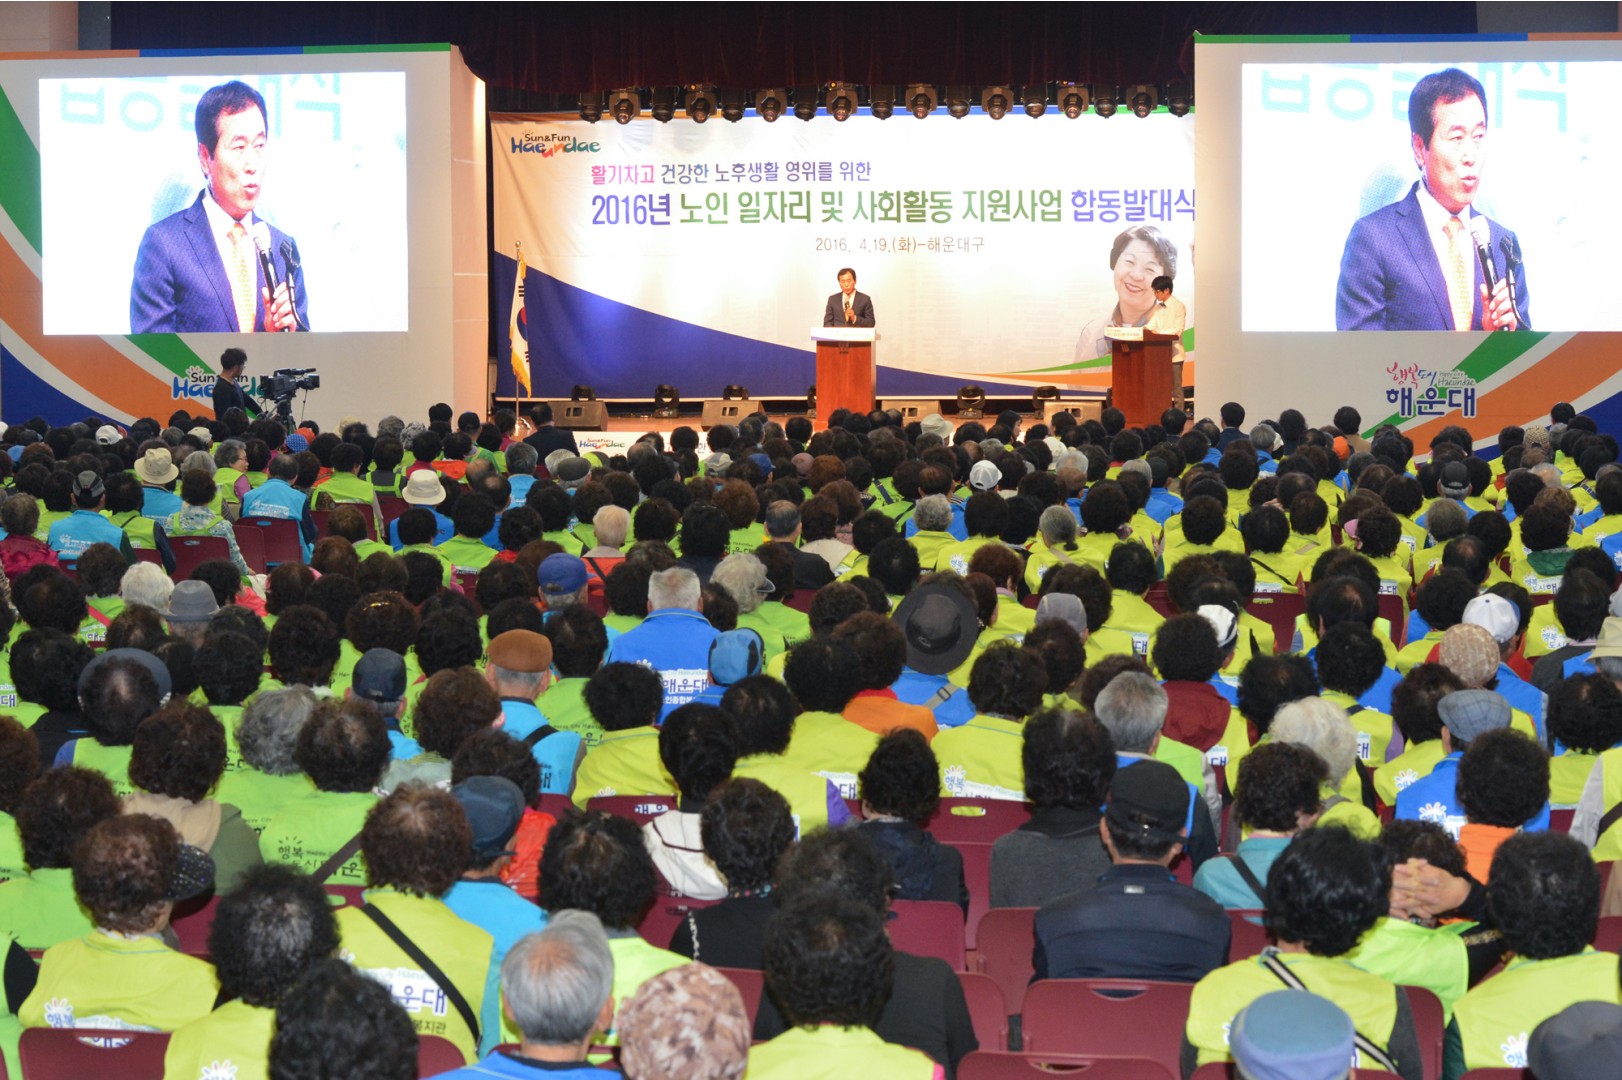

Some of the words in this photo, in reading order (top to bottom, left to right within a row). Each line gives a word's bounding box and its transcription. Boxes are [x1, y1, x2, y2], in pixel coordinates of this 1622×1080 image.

[511, 136, 601, 158] Haeundae
[524, 133, 571, 142] Sun&Fun
[591, 165, 655, 185] 활기차고
[661, 163, 709, 184] 건강한
[715, 162, 779, 183] 노후생활
[785, 161, 833, 182] 영위를
[839, 161, 871, 181] 위한
[592, 193, 671, 226] 2016년
[680, 192, 729, 224] 노인
[738, 190, 811, 223] 일자리
[821, 190, 843, 223] 및
[852, 190, 952, 224] 사회활동
[962, 189, 1062, 223] 지원사업
[1071, 188, 1195, 223] 합동발대식
[1386, 388, 1475, 416] 해운대
[278, 845, 304, 860] 행복
[387, 984, 446, 1014] 운대
